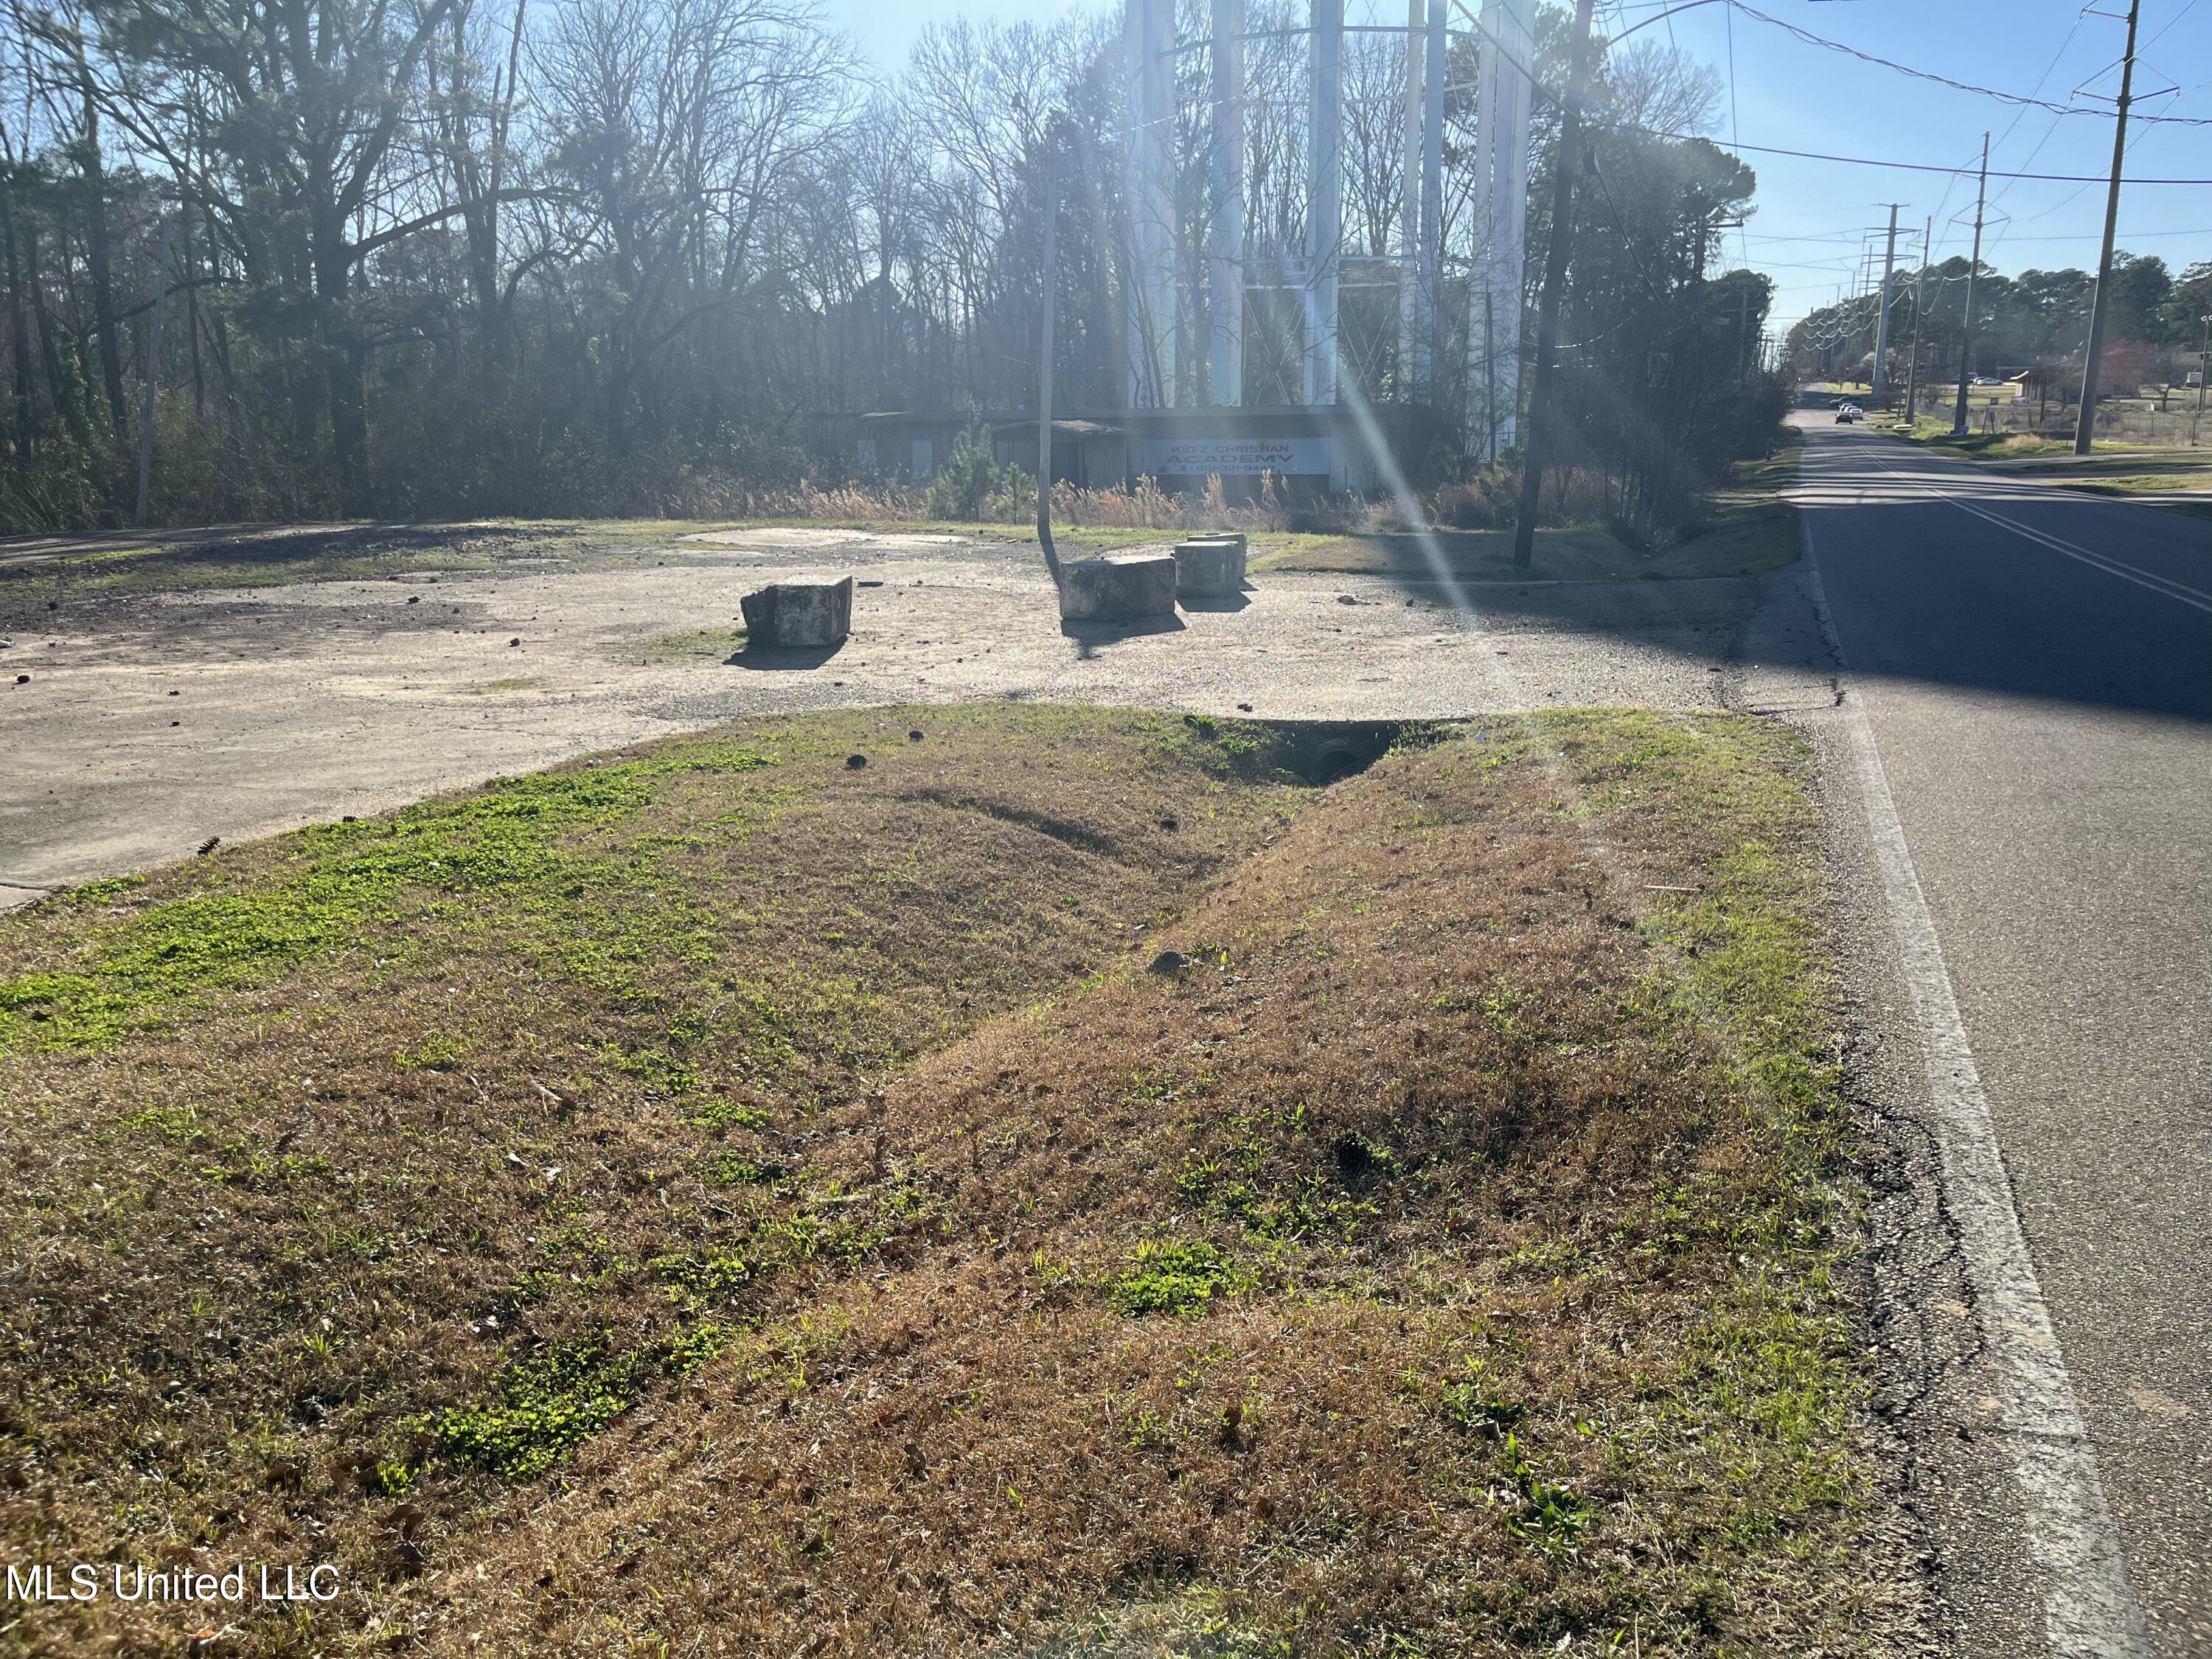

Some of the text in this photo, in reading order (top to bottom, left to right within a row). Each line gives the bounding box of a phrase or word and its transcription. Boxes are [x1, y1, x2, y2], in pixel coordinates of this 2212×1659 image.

[1171, 442, 1289, 453] KID'Z CHRISTIAN
[1166, 454, 1294, 463] ACADEMY
